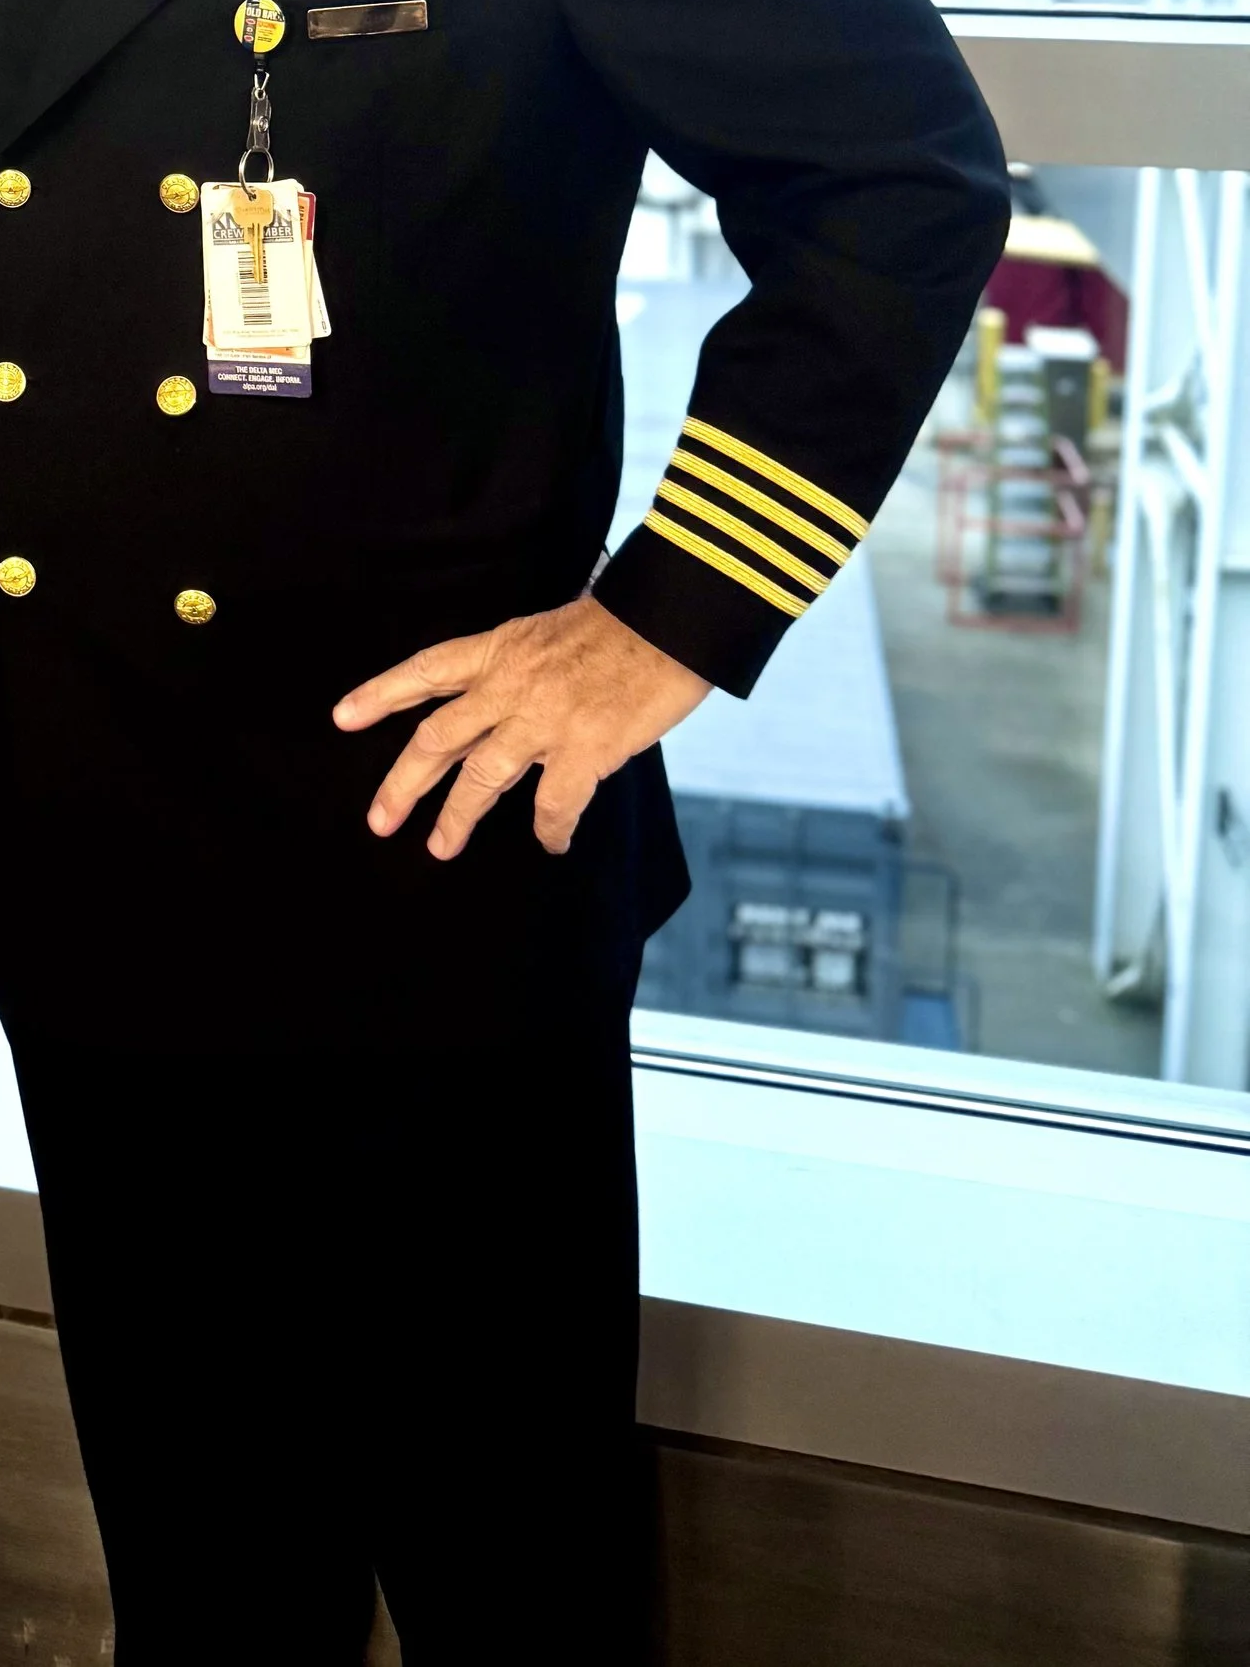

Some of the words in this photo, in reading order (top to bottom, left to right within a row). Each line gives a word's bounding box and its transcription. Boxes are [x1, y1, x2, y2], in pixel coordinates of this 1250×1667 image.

[246, 7, 262, 18] OLD
[213, 226, 292, 239] CREWMBER
[235, 366, 248, 374] THE
[249, 366, 267, 375] DELTA
[217, 373, 247, 382] CONNECT.
[248, 375, 275, 383] ENGAGE.
[276, 376, 302, 384] INFORM.
